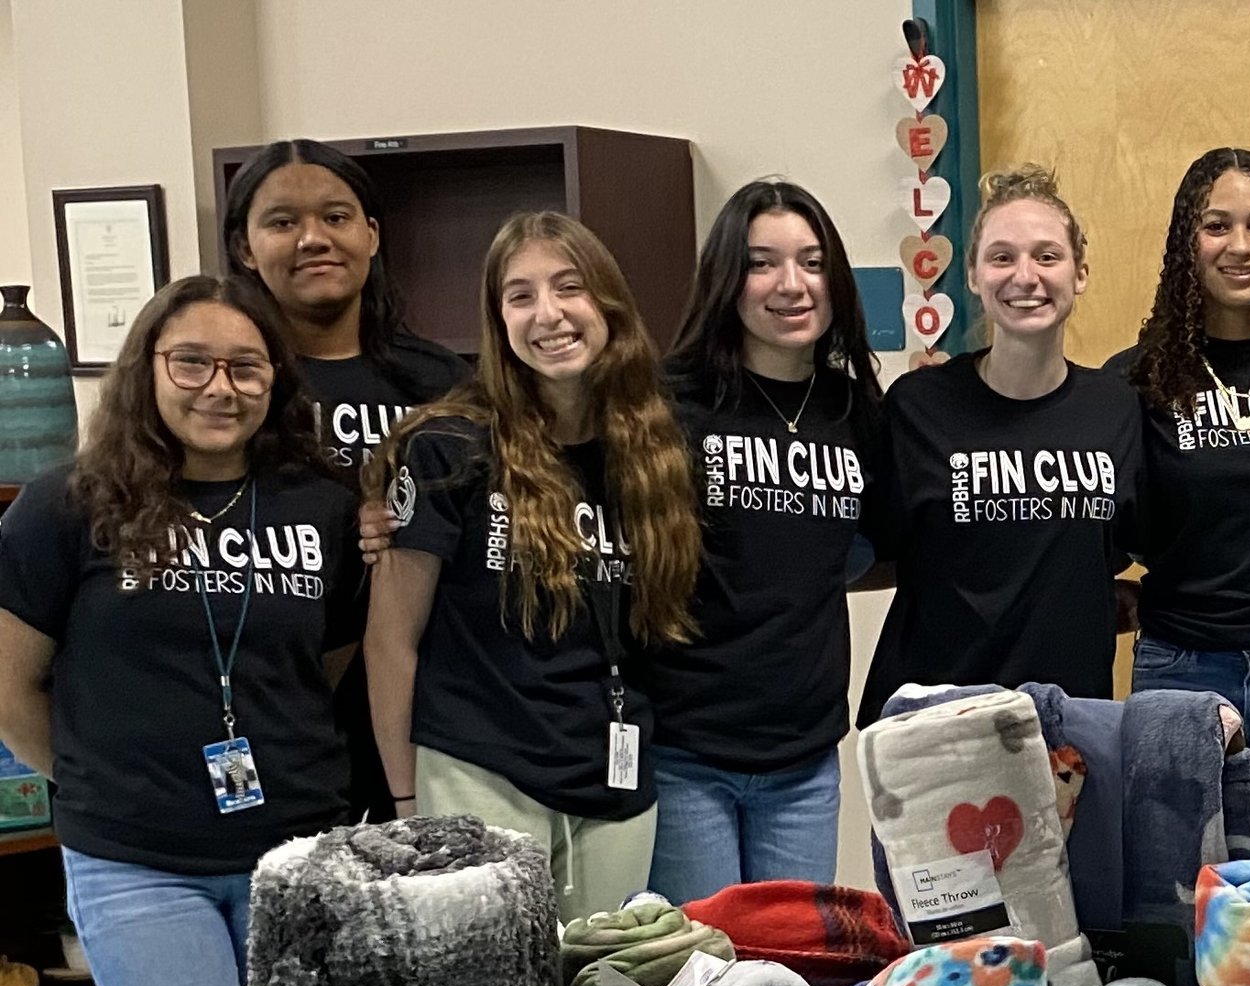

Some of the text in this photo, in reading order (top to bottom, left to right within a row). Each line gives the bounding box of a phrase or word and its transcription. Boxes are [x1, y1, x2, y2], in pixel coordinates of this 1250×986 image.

[332, 402, 415, 445] CLU
[705, 456, 724, 507] RPBHS
[726, 435, 865, 494] FIN CLUB
[971, 449, 1116, 495] FIN CLUB
[729, 485, 805, 515] FOSTERS
[812, 493, 827, 518] IN
[952, 471, 971, 523] RPBHS
[973, 496, 1116, 521] FOSTERS IN NEED
[219, 524, 323, 571] CLUB
[486, 512, 510, 572] RPBHS
[281, 569, 324, 601] NEED
[911, 895, 940, 911] Fleece
[940, 888, 979, 904] Throw
